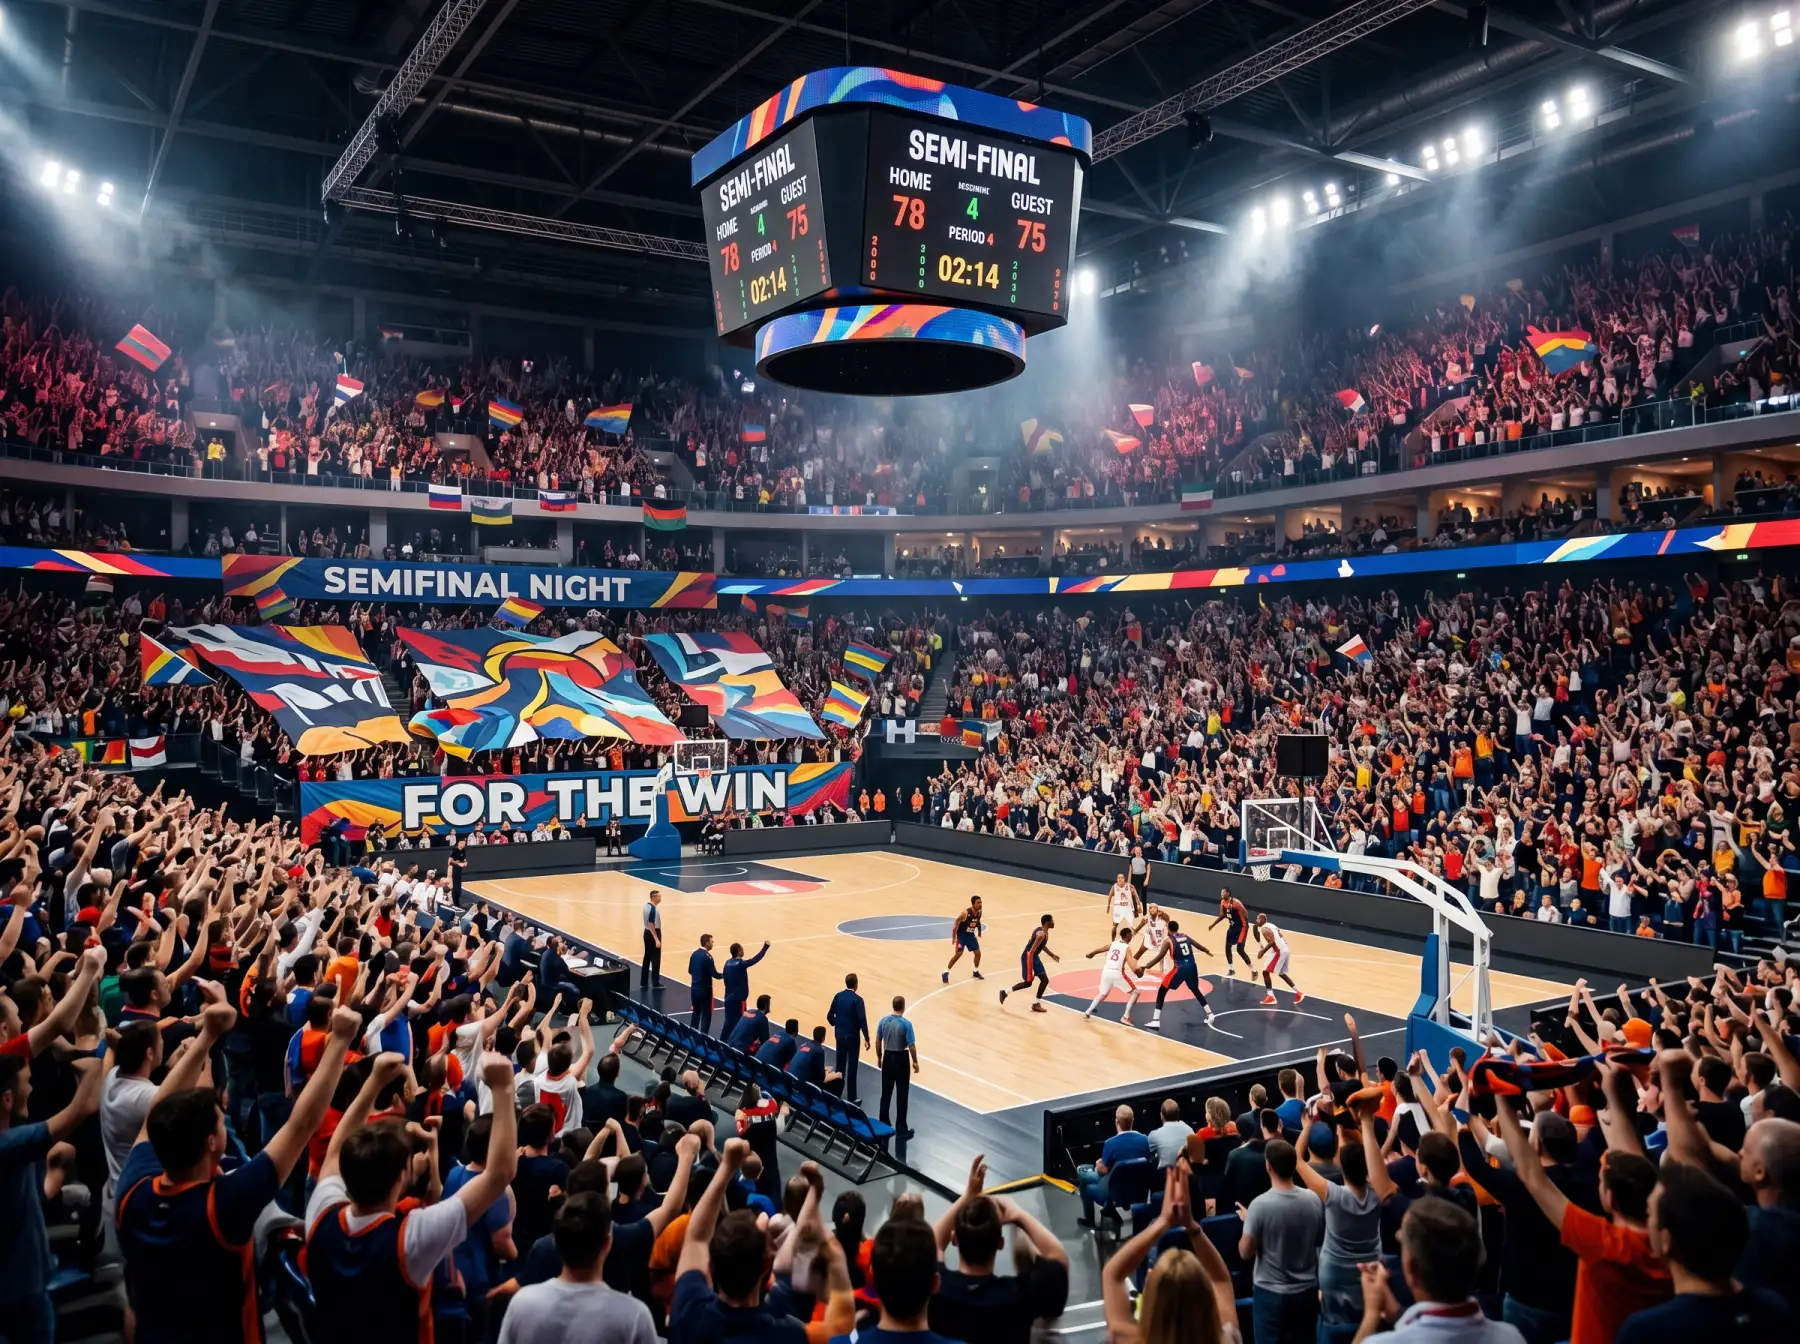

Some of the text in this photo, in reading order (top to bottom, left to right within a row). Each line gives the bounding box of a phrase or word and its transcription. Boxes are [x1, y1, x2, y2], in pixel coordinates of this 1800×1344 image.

[908, 129, 1041, 186] SEMI-FINAL
[719, 143, 796, 212] SEMI-FINAL
[780, 175, 807, 205] GUEST
[889, 166, 932, 192] HOME
[892, 194, 926, 230] 78
[966, 197, 979, 220] 4
[1011, 192, 1054, 215] GUEST
[716, 216, 739, 242] HOME
[757, 212, 766, 236] 4
[786, 203, 809, 241] 75
[948, 225, 995, 246] PERIOD 4
[1016, 219, 1046, 253] 75
[720, 242, 741, 276] 78
[751, 241, 772, 263] PERIOD
[750, 266, 788, 305] 02:14
[938, 254, 1000, 290] 02:14
[323, 566, 632, 602] SEMIFINAL NIGHT
[404, 771, 787, 830] FOR THE WIN
